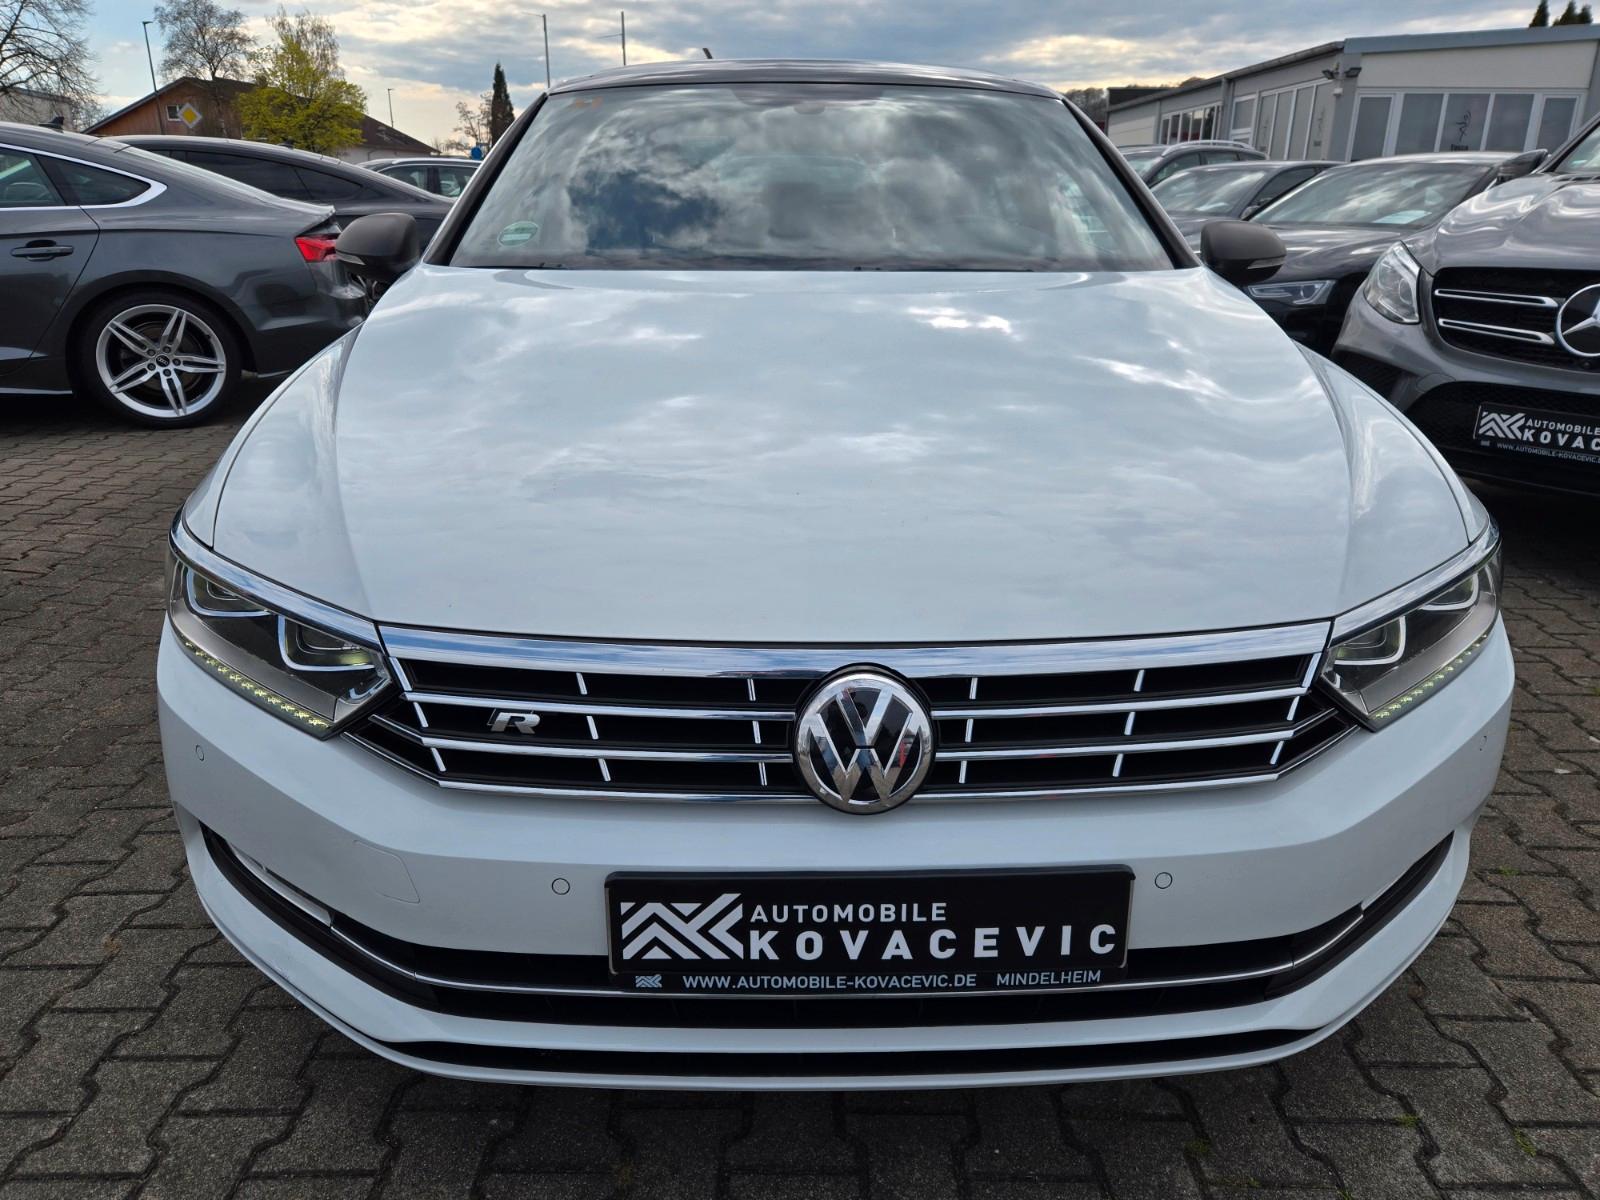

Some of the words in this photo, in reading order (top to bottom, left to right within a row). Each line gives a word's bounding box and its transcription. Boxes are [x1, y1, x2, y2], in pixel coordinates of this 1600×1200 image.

[1525, 418, 1600, 436] AUTOMOBILE
[490, 711, 541, 734] R
[750, 902, 948, 923] AUTOMOBILE
[750, 923, 1117, 961] KOVACEVIC
[682, 973, 977, 989] WWW.AUTOMOBILE-KOVACEVIC.DE
[996, 970, 1101, 986] MINDELHEIM
